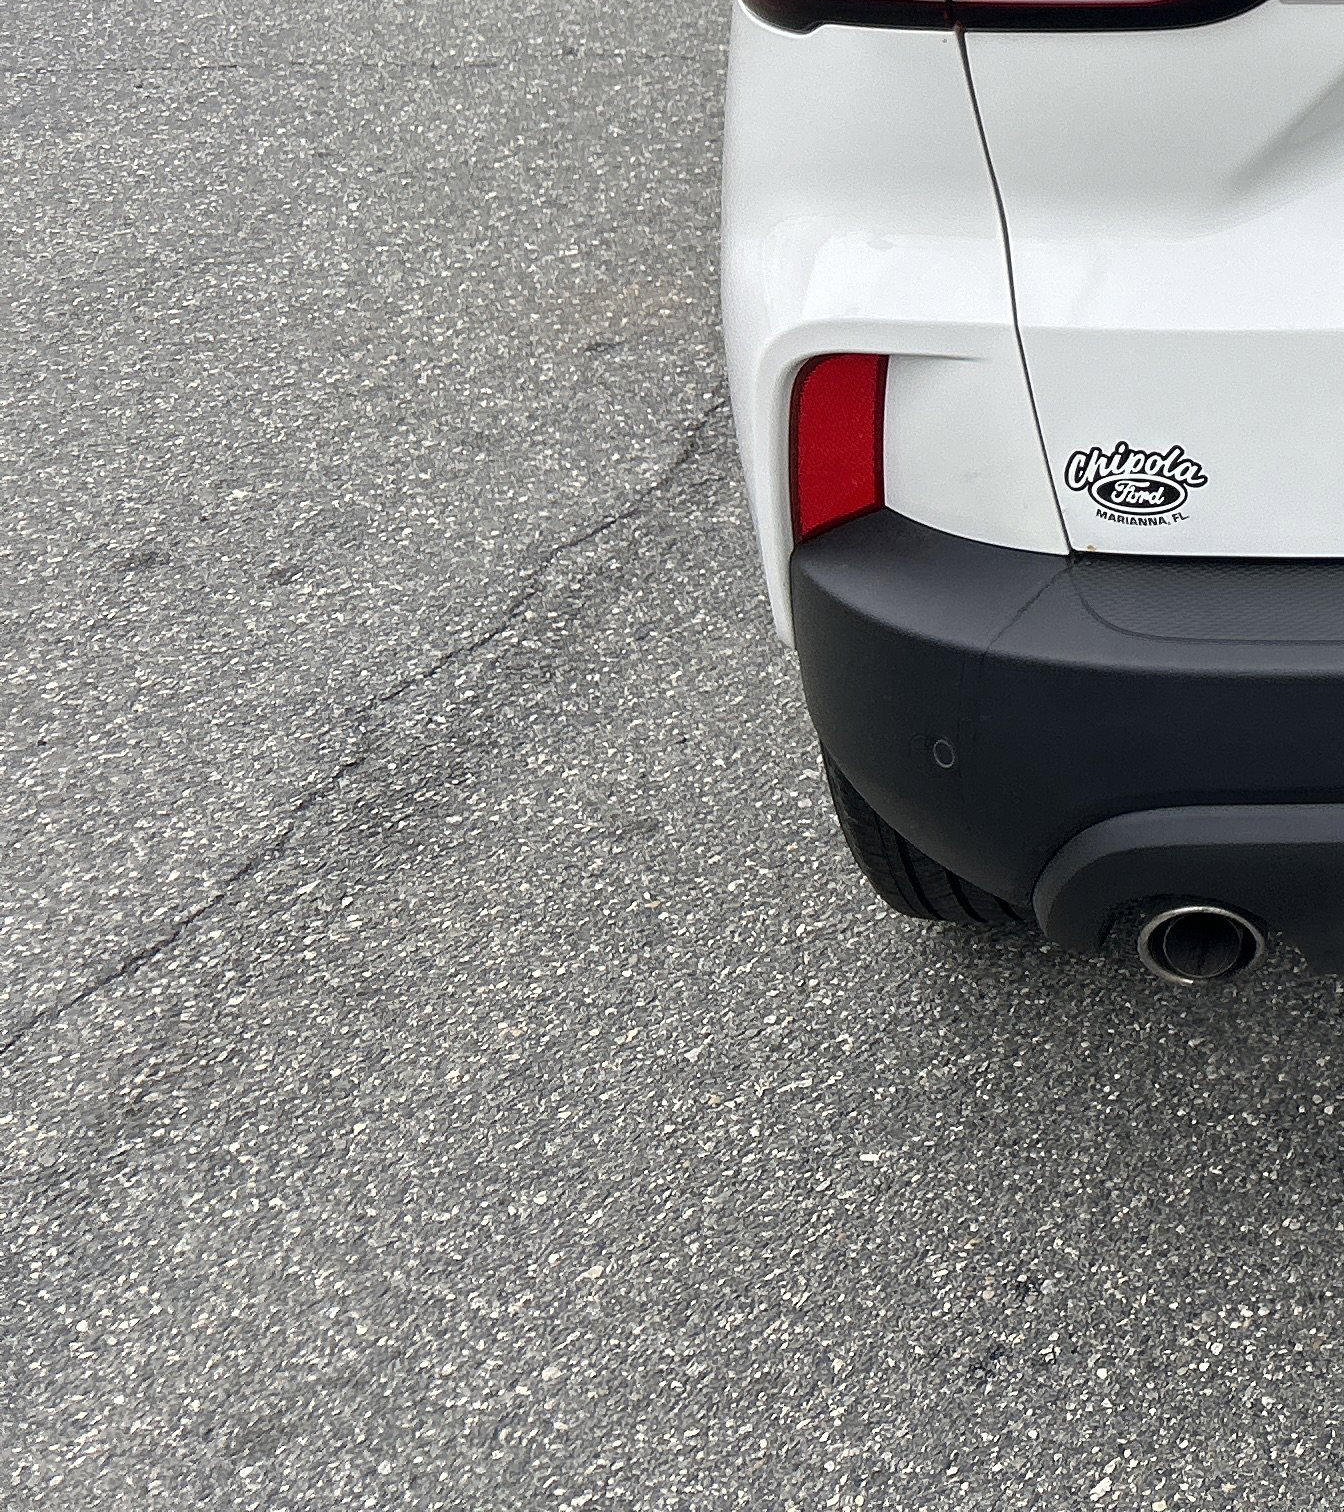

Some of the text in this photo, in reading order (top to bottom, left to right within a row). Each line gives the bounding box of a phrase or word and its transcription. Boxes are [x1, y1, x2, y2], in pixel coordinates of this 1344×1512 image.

[1065, 441, 1207, 491] Chipola
[1111, 479, 1165, 504] Ford
[1095, 508, 1171, 527] MARIANNA,
